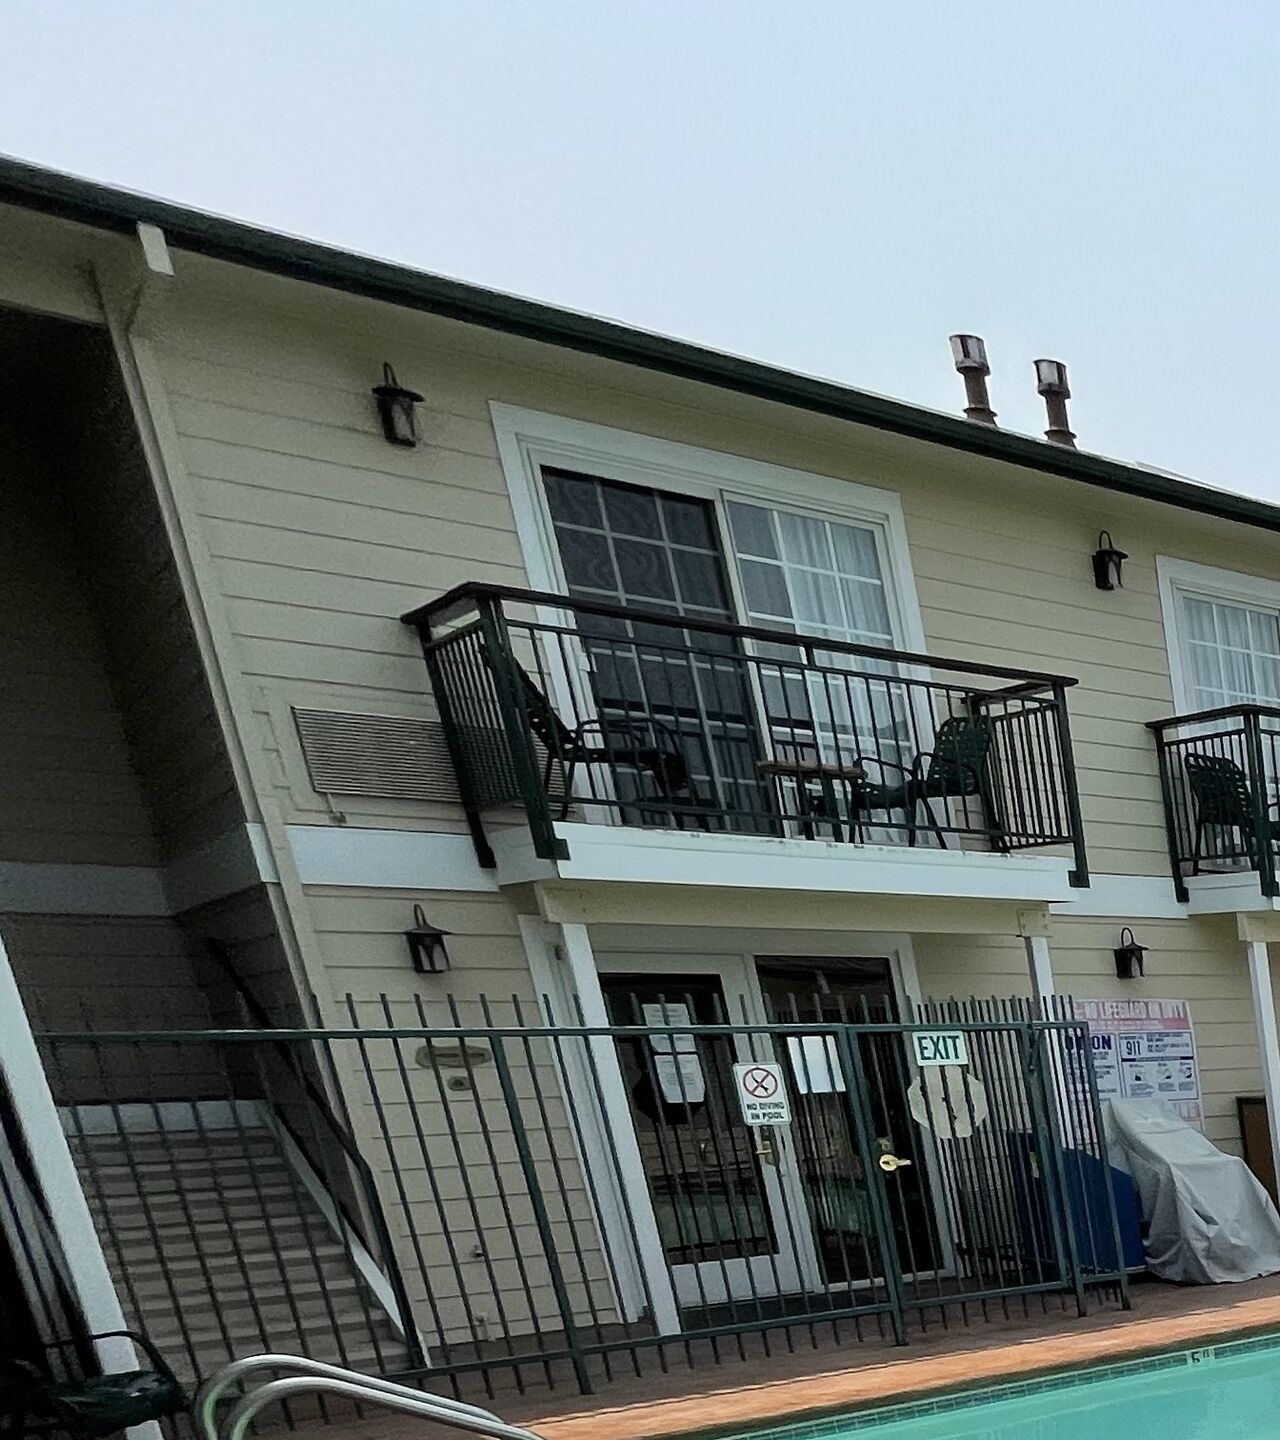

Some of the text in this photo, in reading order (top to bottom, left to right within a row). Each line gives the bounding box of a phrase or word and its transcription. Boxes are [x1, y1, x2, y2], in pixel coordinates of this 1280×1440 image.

[917, 1035, 960, 1060] EXIT
[1126, 1040, 1141, 1056] 911
[759, 1102, 785, 1110] DIVING
[751, 1111, 785, 1120] IN POOL
